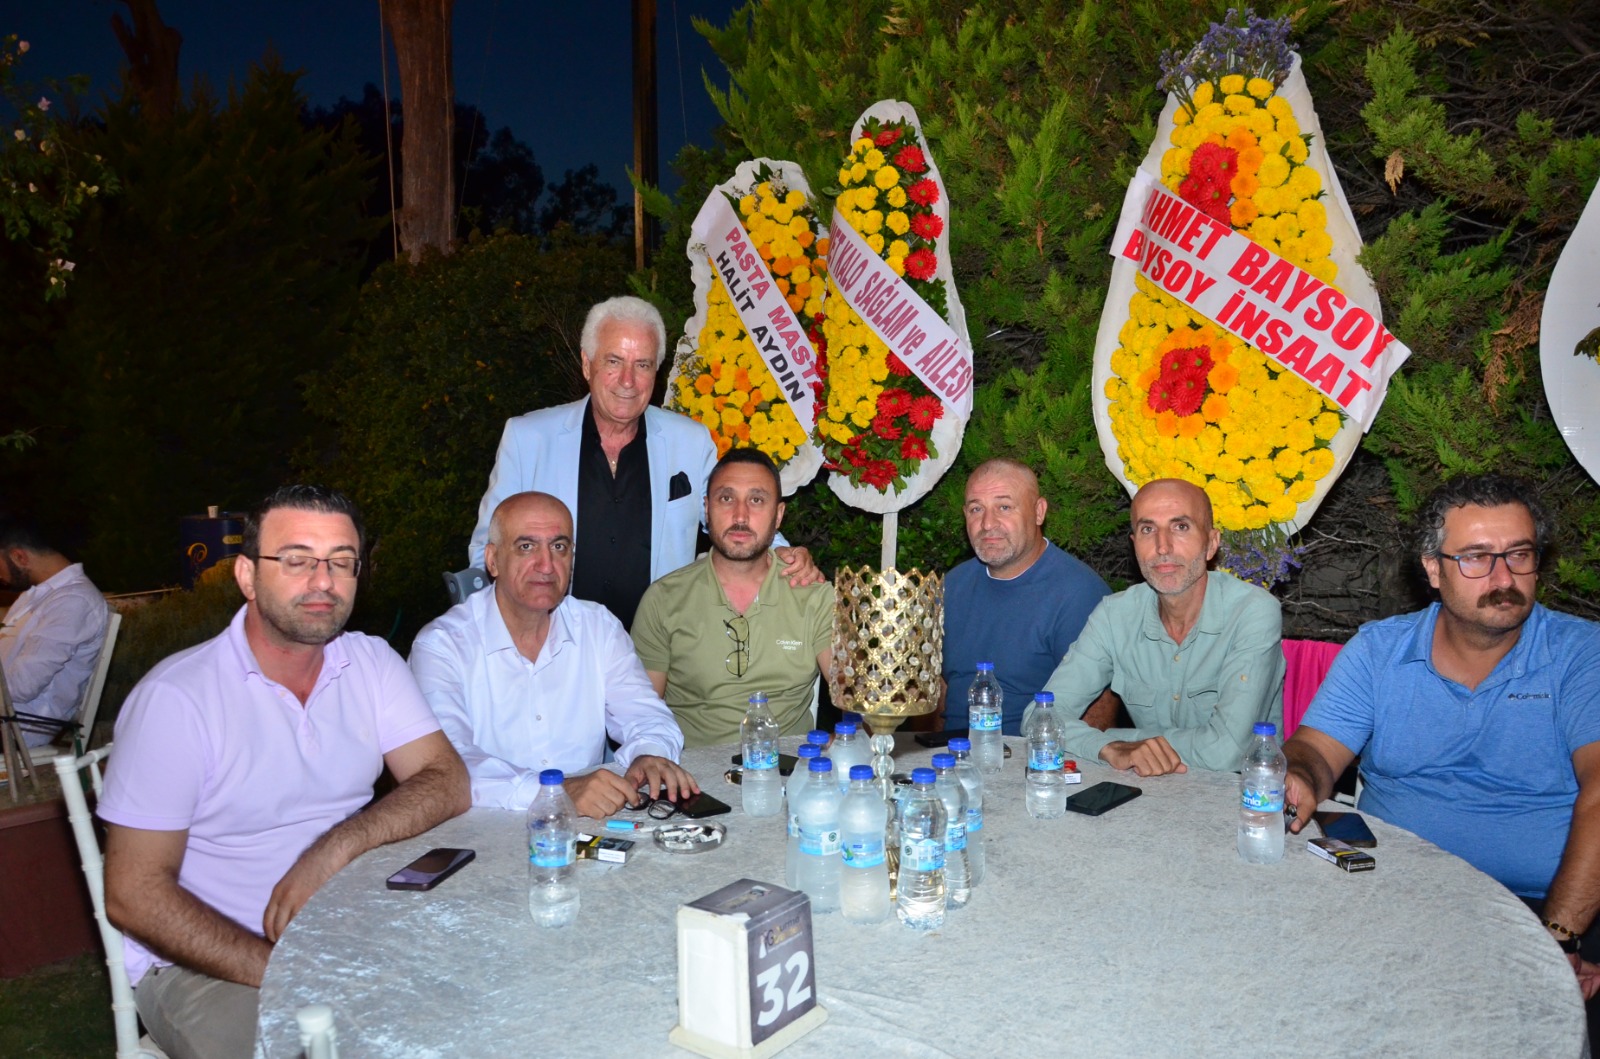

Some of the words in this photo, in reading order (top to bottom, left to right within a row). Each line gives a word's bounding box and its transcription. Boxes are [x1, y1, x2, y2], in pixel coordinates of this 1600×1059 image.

[716, 250, 755, 312] HALİT
[752, 325, 805, 402] AYDIN
[726, 227, 770, 300] PASTA
[768, 304, 819, 389] MAST
[854, 271, 919, 341] SAĞLAM
[898, 324, 926, 356] ve
[1228, 241, 1395, 369] BAYSOY
[756, 951, 811, 1026] 32
